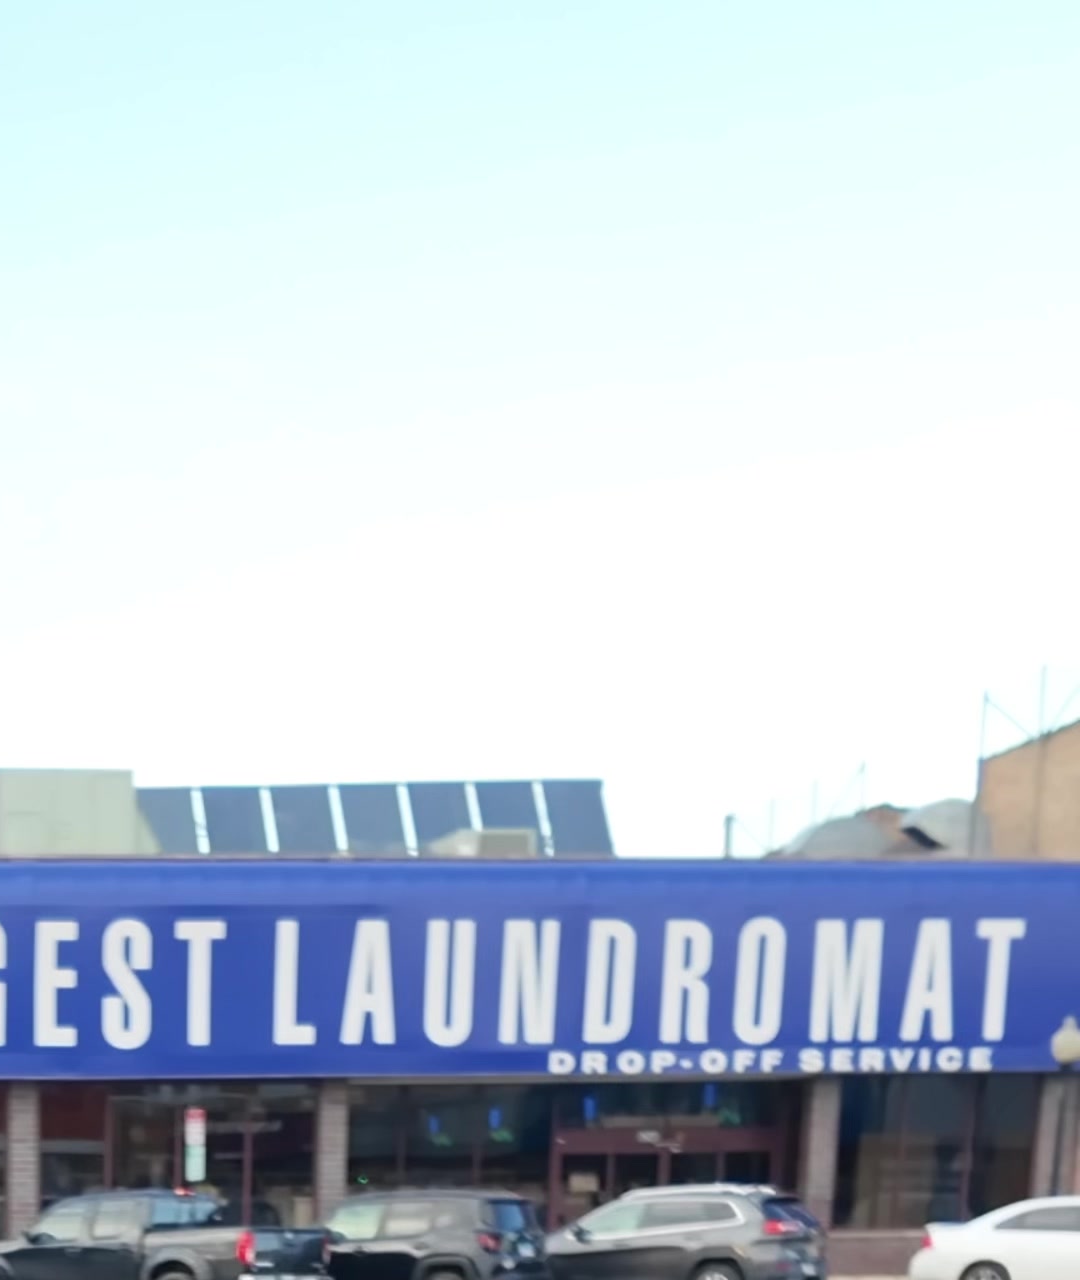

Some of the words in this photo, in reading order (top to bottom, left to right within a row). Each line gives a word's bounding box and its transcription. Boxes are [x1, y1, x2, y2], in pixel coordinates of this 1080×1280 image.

[272, 915, 1027, 1047] LAUNDROMAT
[547, 1048, 783, 1075] DROP-OFF
[798, 1046, 992, 1073] SERVICE
